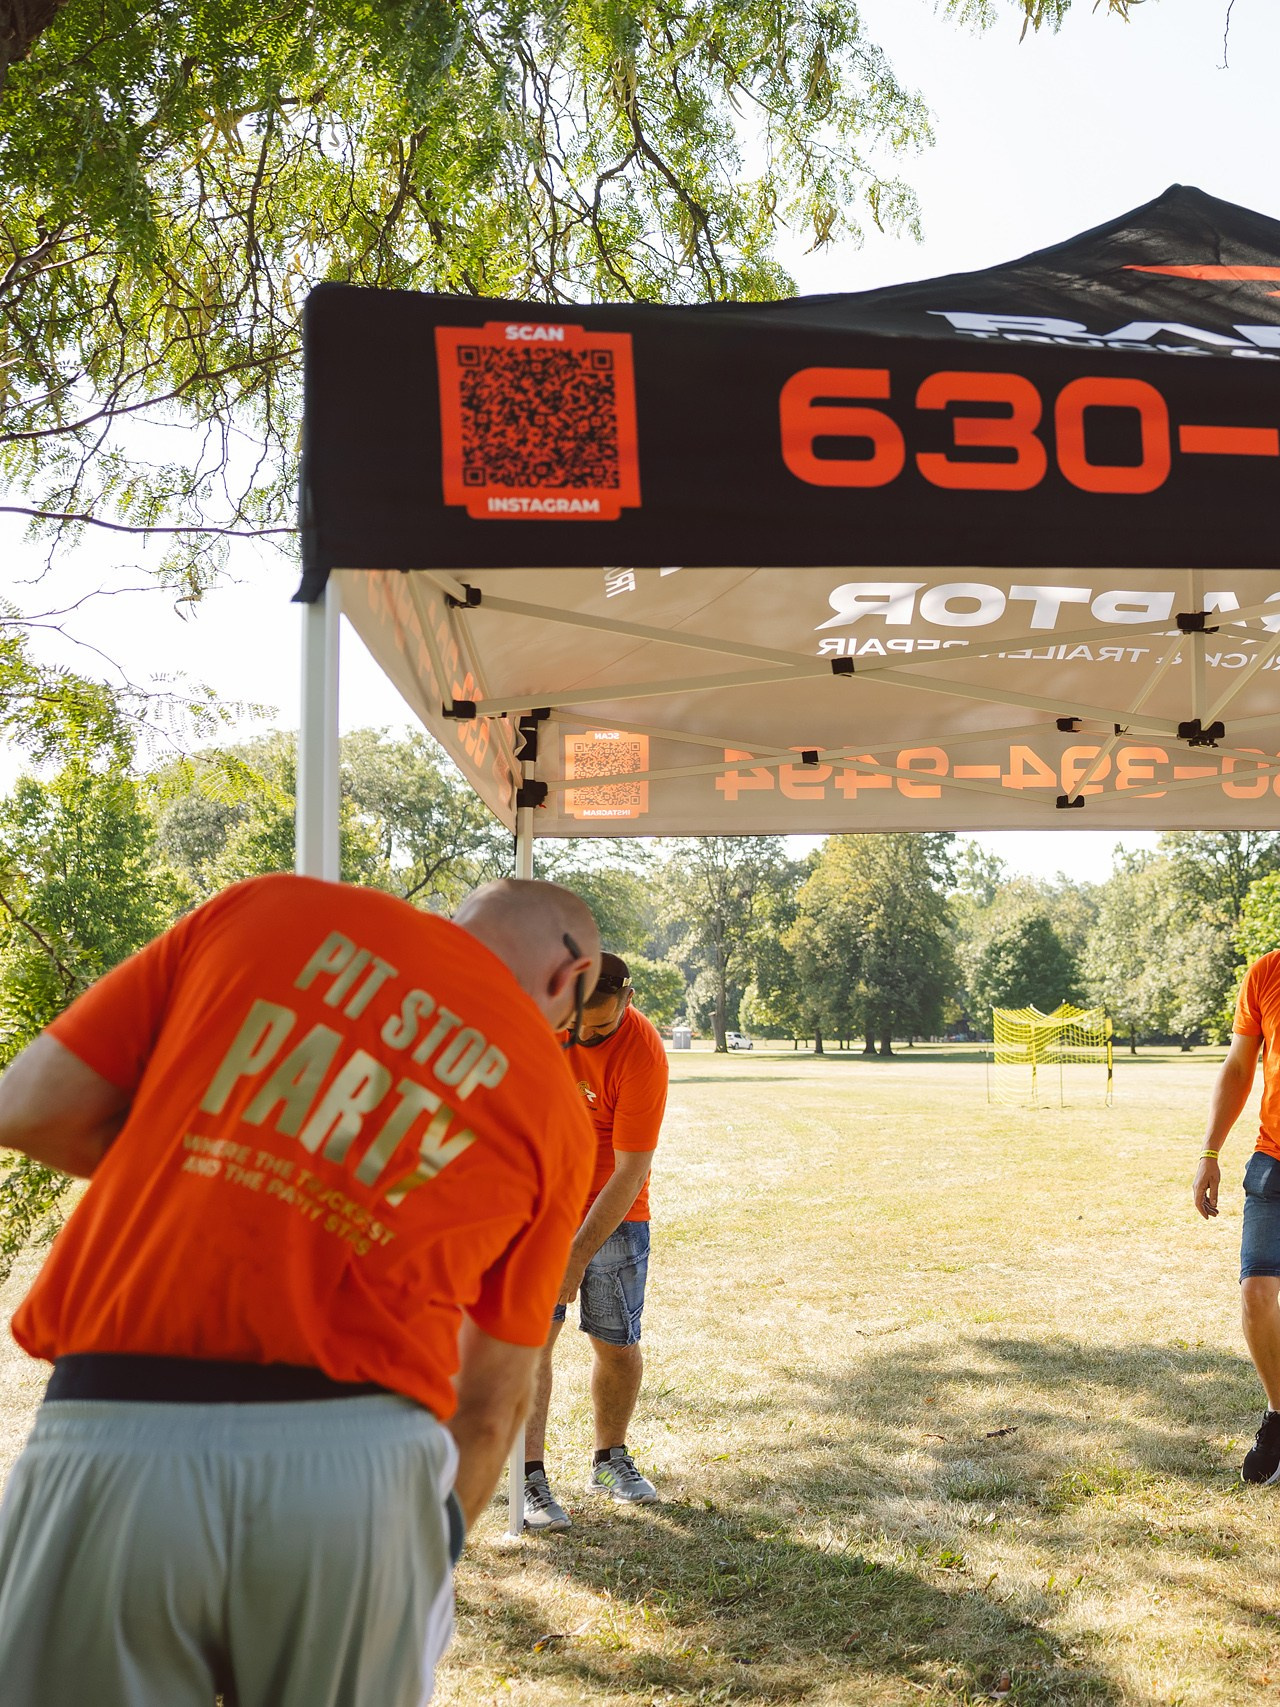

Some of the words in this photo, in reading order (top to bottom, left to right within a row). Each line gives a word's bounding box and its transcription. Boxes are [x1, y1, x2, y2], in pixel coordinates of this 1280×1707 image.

[505, 325, 564, 341] SCAN
[487, 497, 600, 513] INSTAGRAM
[293, 930, 399, 1021] PIT
[381, 988, 509, 1102] STOP
[199, 998, 478, 1208] PARTY
[225, 1162, 264, 1192] THE
[255, 1151, 295, 1180] THE
